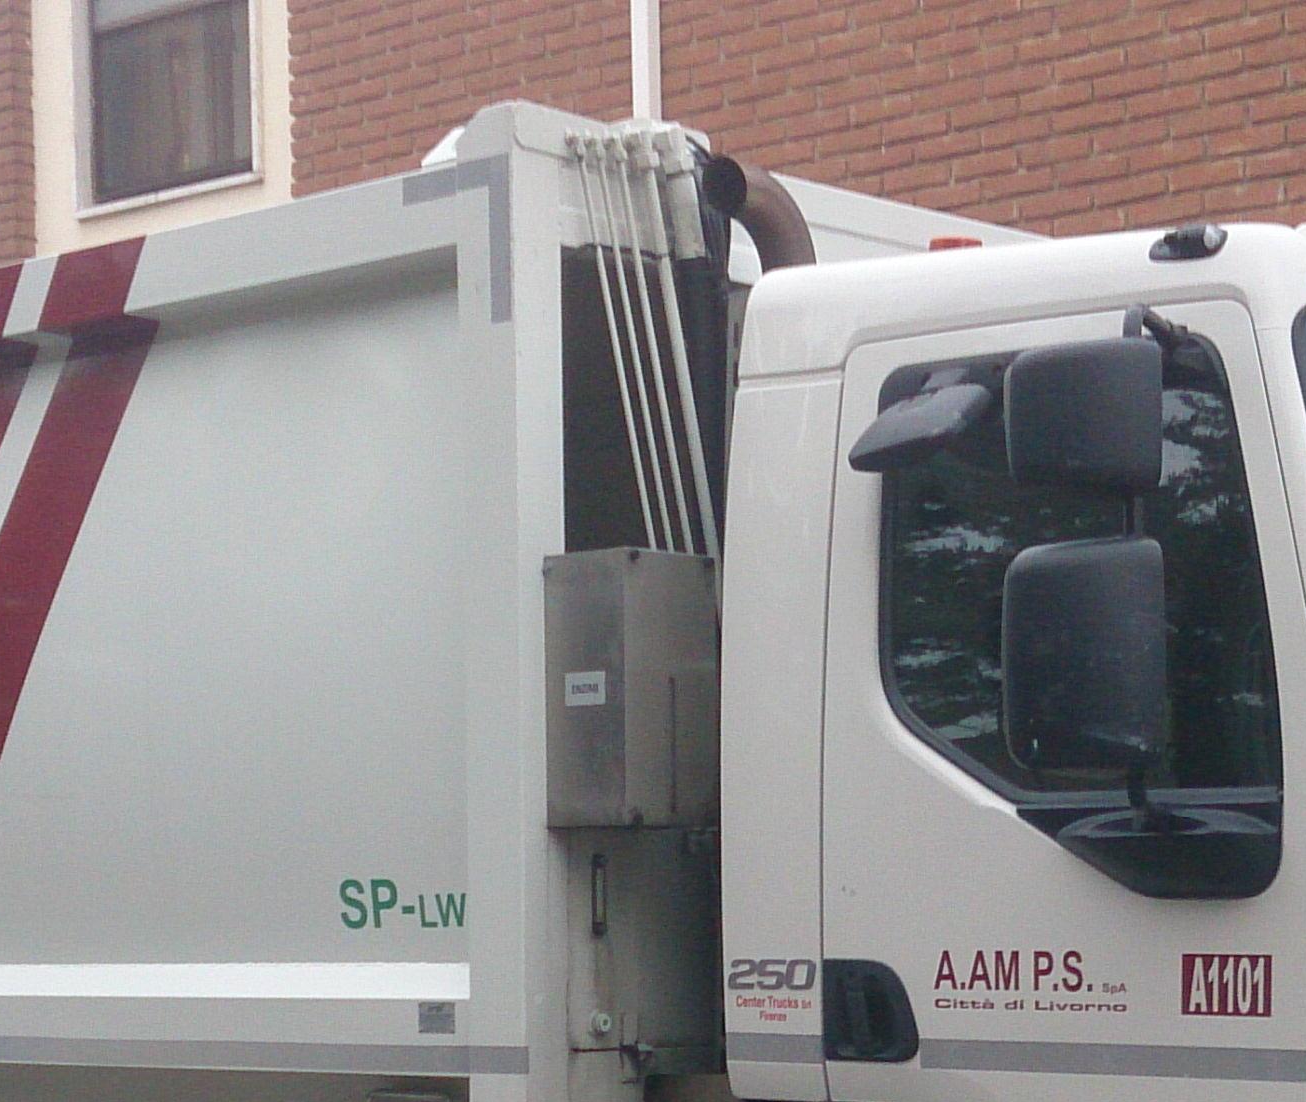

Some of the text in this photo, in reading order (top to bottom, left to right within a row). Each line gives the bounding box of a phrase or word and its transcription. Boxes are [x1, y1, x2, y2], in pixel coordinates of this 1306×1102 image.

[339, 878, 467, 930] SP-LW
[728, 959, 817, 990] 250
[1188, 956, 1266, 1015] A1101
[1101, 982, 1127, 995] SpA
[736, 995, 766, 1008] Center
[767, 995, 799, 1009] Trucks
[934, 997, 1128, 1012] Città di Livorno
